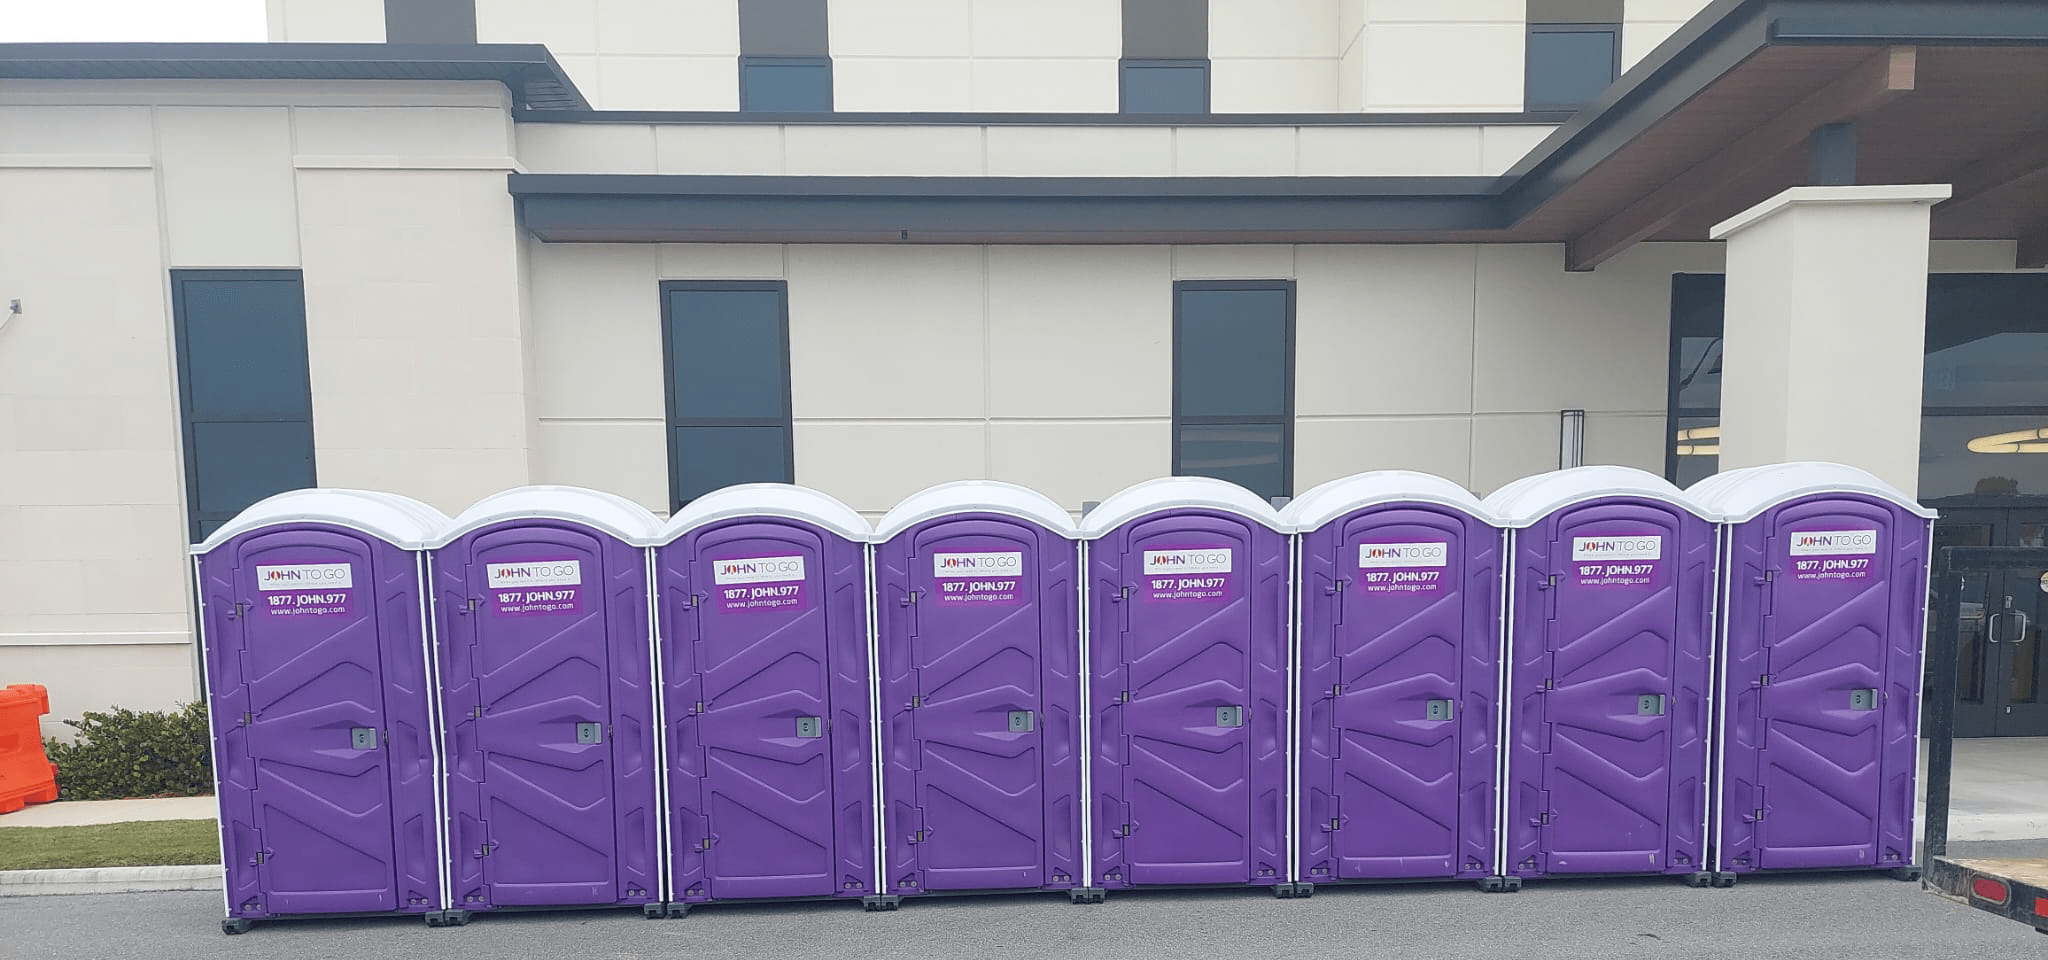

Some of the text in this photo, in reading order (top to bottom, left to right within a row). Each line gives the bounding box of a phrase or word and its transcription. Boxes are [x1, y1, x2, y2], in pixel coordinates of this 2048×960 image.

[1579, 540, 1656, 552] JOHN TO GO
[1796, 535, 1871, 547] JOHN TO GO
[1365, 547, 1441, 558] JOHN TO GO
[941, 557, 1017, 568] JOHN TO GO
[1150, 553, 1226, 565] JOHN TO GO
[495, 565, 574, 579] JOHN TO GO
[721, 561, 798, 575] JOHN TO GO
[264, 568, 345, 581] JOHN TO GO
[1797, 570, 1866, 579] www.johntogo.com
[1581, 577, 1650, 585] www.johntogo.com
[1368, 583, 1436, 592] www.johntogo.com
[944, 593, 1014, 601] www.johntogo.com
[1153, 590, 1222, 599] www.johntogo.com
[501, 603, 573, 612] www.johntogo.com
[726, 599, 798, 608] www.johntogo.com
[271, 606, 345, 615] www.johntogo.com
